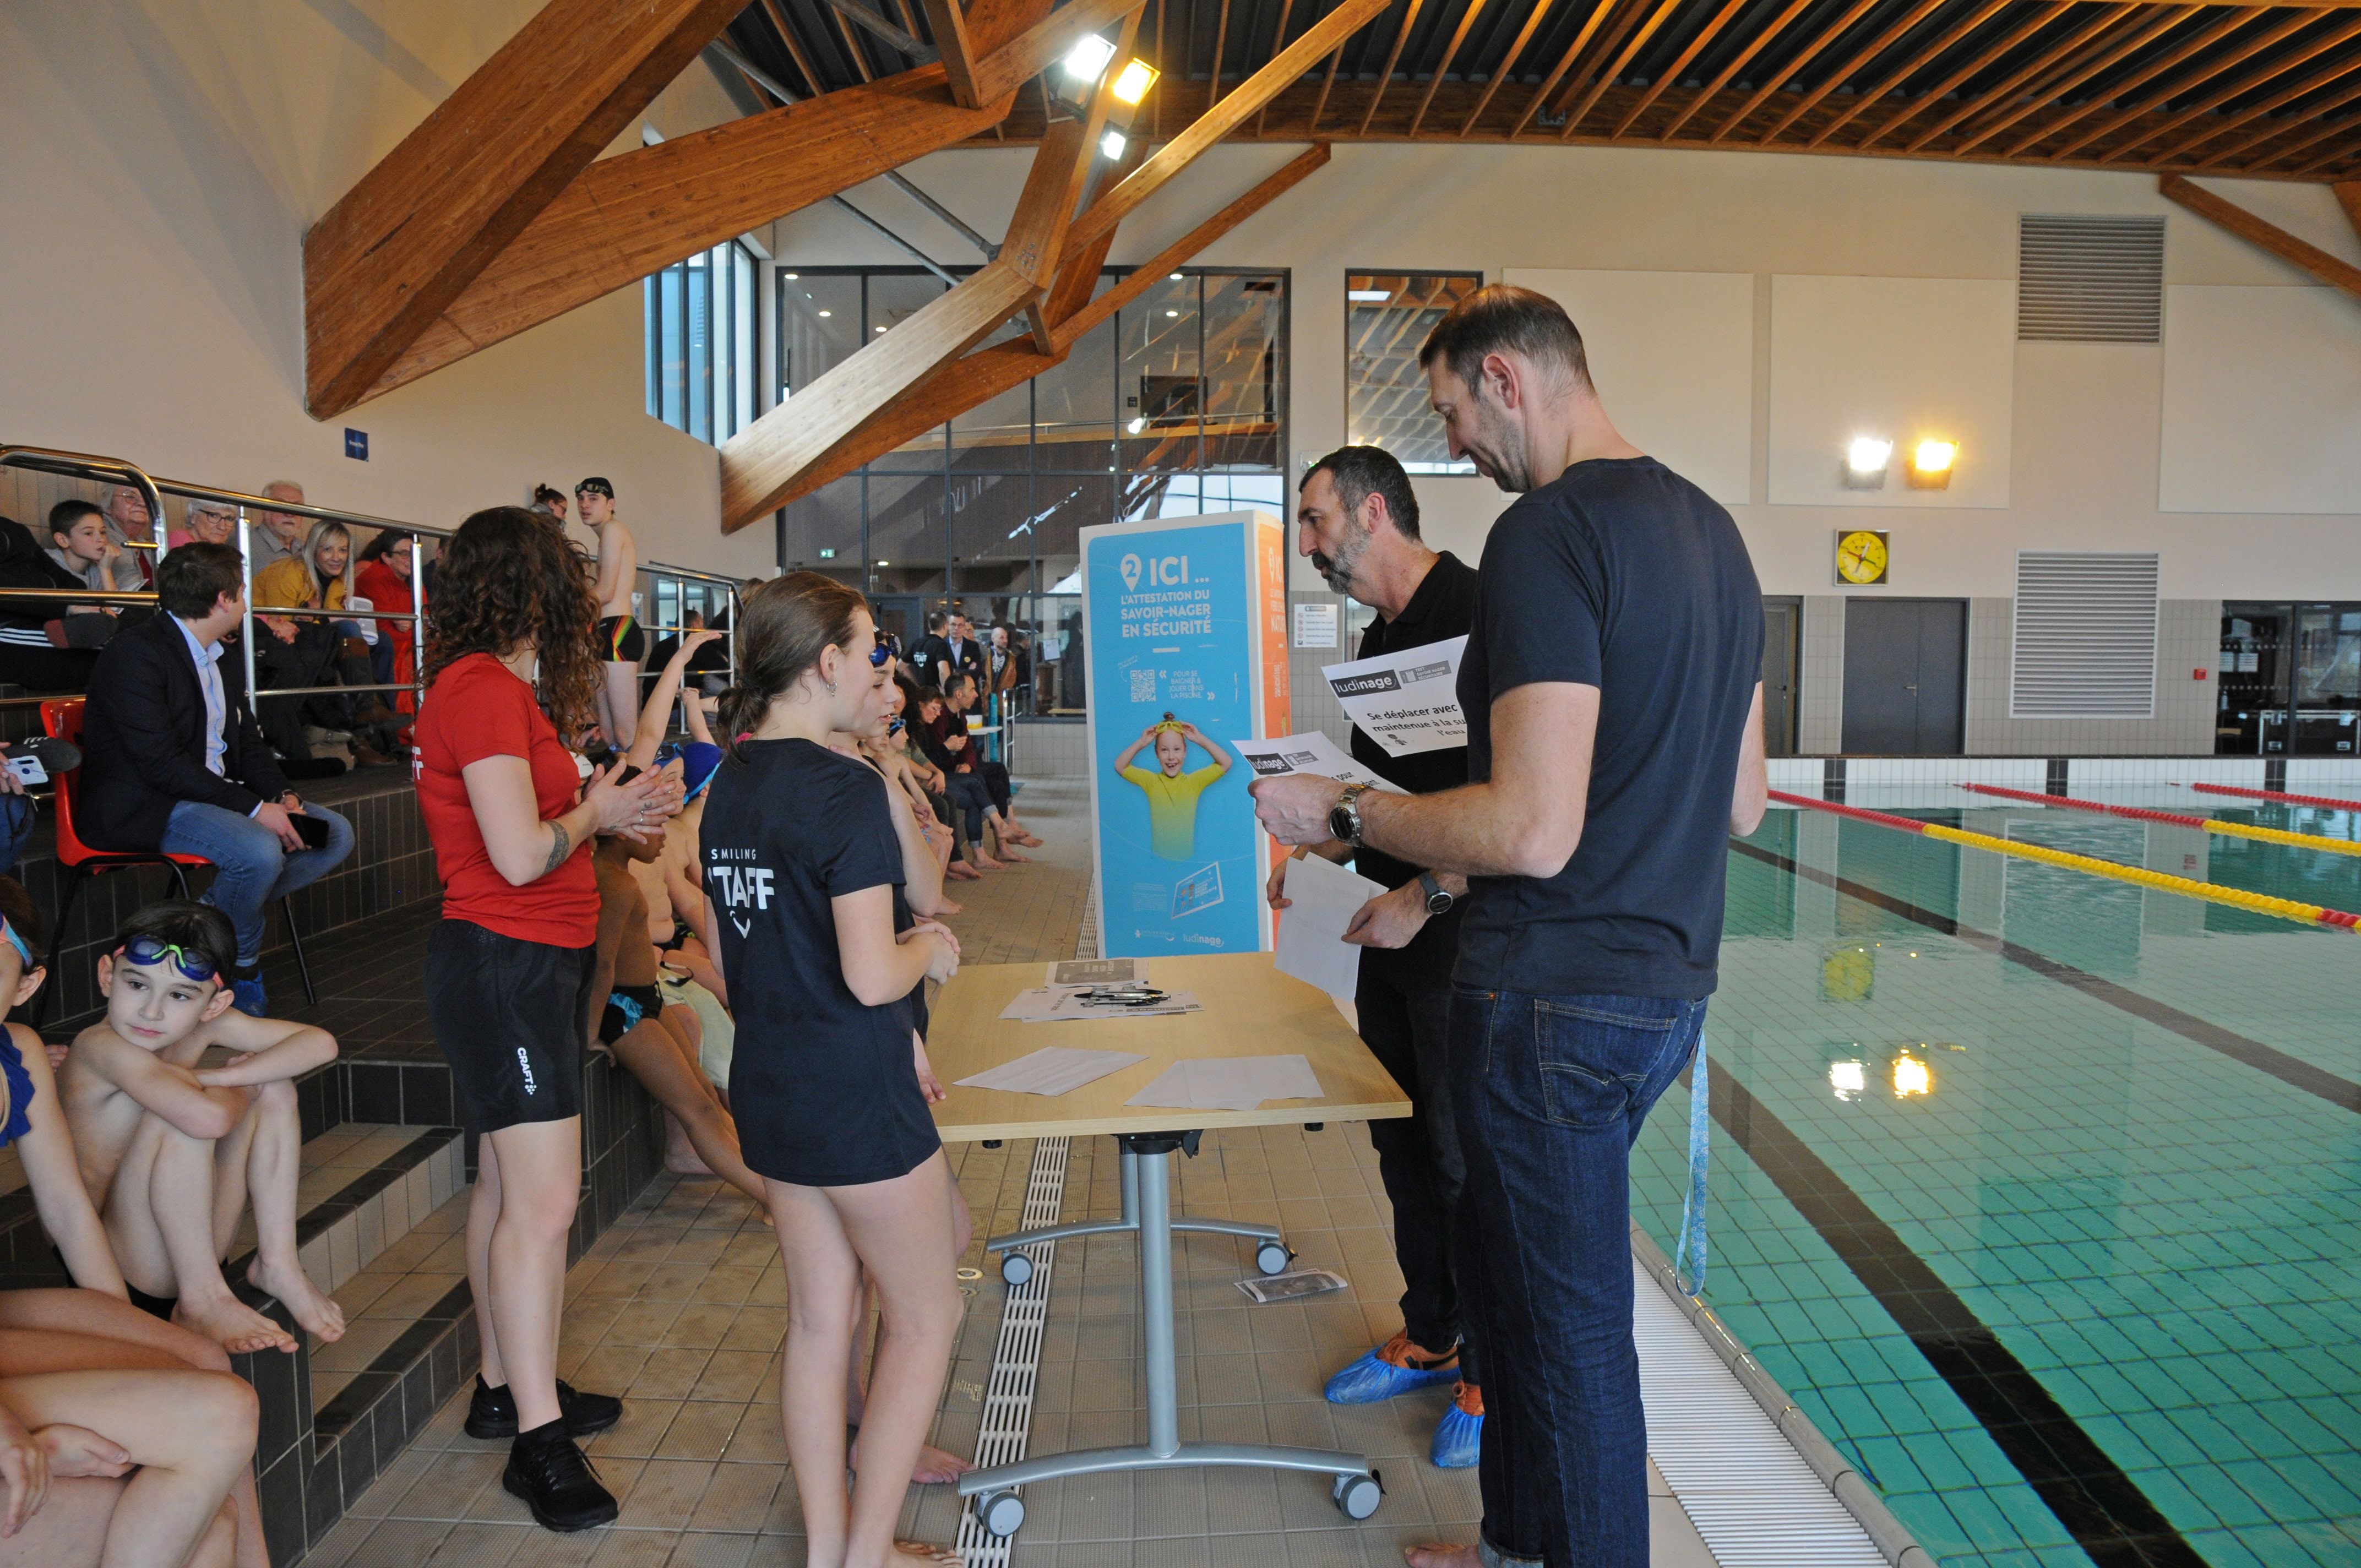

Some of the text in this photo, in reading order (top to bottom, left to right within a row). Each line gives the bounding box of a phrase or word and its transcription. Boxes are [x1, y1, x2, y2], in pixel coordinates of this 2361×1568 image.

[1121, 590, 1209, 605] L'ATTESTATION DU
[1122, 615, 1211, 638] EN SÉCURITÉ
[1335, 677, 1392, 693] ludinage
[1384, 708, 1430, 720] déplacer
[1432, 704, 1458, 714] avec
[1372, 722, 1432, 732] maintenue
[1249, 757, 1286, 770] ludinage
[1336, 771, 1354, 782] pour
[711, 848, 756, 860] SMILING
[1183, 933, 1221, 946] ludinage
[518, 1047, 534, 1084] CRAFT
